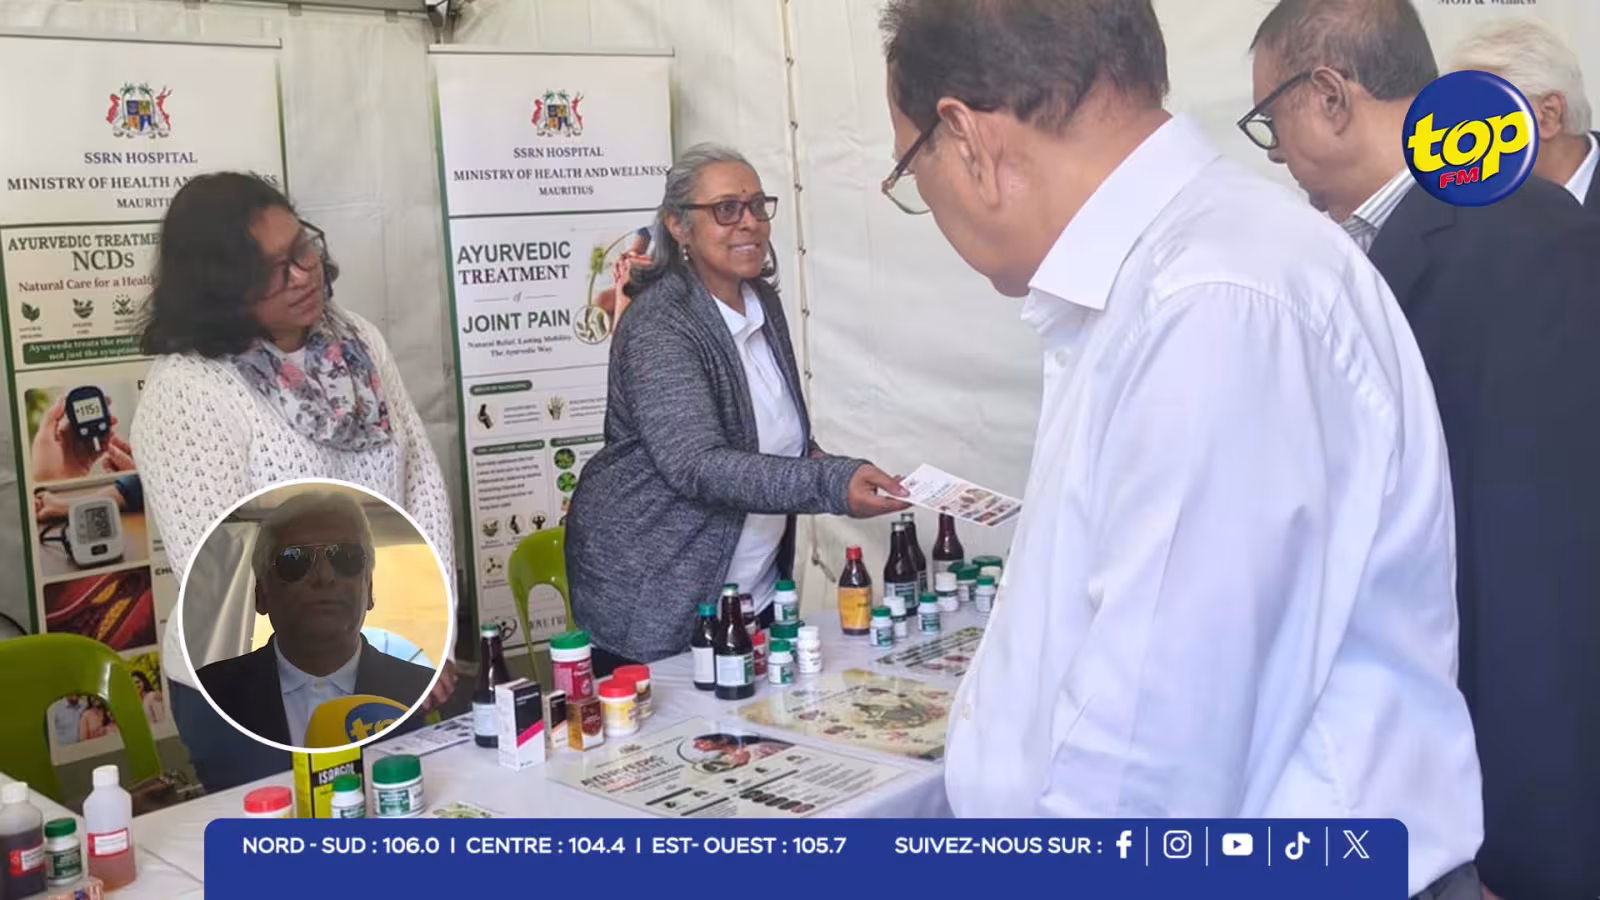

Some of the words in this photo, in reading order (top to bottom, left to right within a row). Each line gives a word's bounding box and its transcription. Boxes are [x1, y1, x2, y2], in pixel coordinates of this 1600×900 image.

[84, 152, 122, 164] SSRN
[126, 152, 198, 164] HOSPITAL
[513, 147, 544, 159] SSRN
[547, 147, 604, 158] HOSPITAL
[454, 168, 513, 181] MINISTRY
[517, 168, 532, 180] OF
[534, 167, 585, 179] HEALTH
[585, 167, 608, 178] AND
[611, 165, 669, 177] WELLNESS
[8, 177, 84, 191] MINISTRY
[89, 177, 110, 189] OF
[113, 176, 170, 189] HEALTH
[173, 176, 192, 188] AN
[539, 185, 594, 196] MAURITIUS
[116, 197, 174, 209] MAURITI
[8, 235, 92, 251] AYURVEDIC
[94, 232, 160, 248] TREATME
[71, 249, 135, 271] NCDs
[457, 241, 571, 265] AYURVEDIC
[458, 264, 570, 286] TREATMENT
[18, 280, 64, 293] Natural
[66, 278, 92, 290] Care
[94, 277, 109, 289] for
[113, 278, 119, 288] a
[462, 312, 521, 334] JOINT
[528, 309, 571, 329] PAIN
